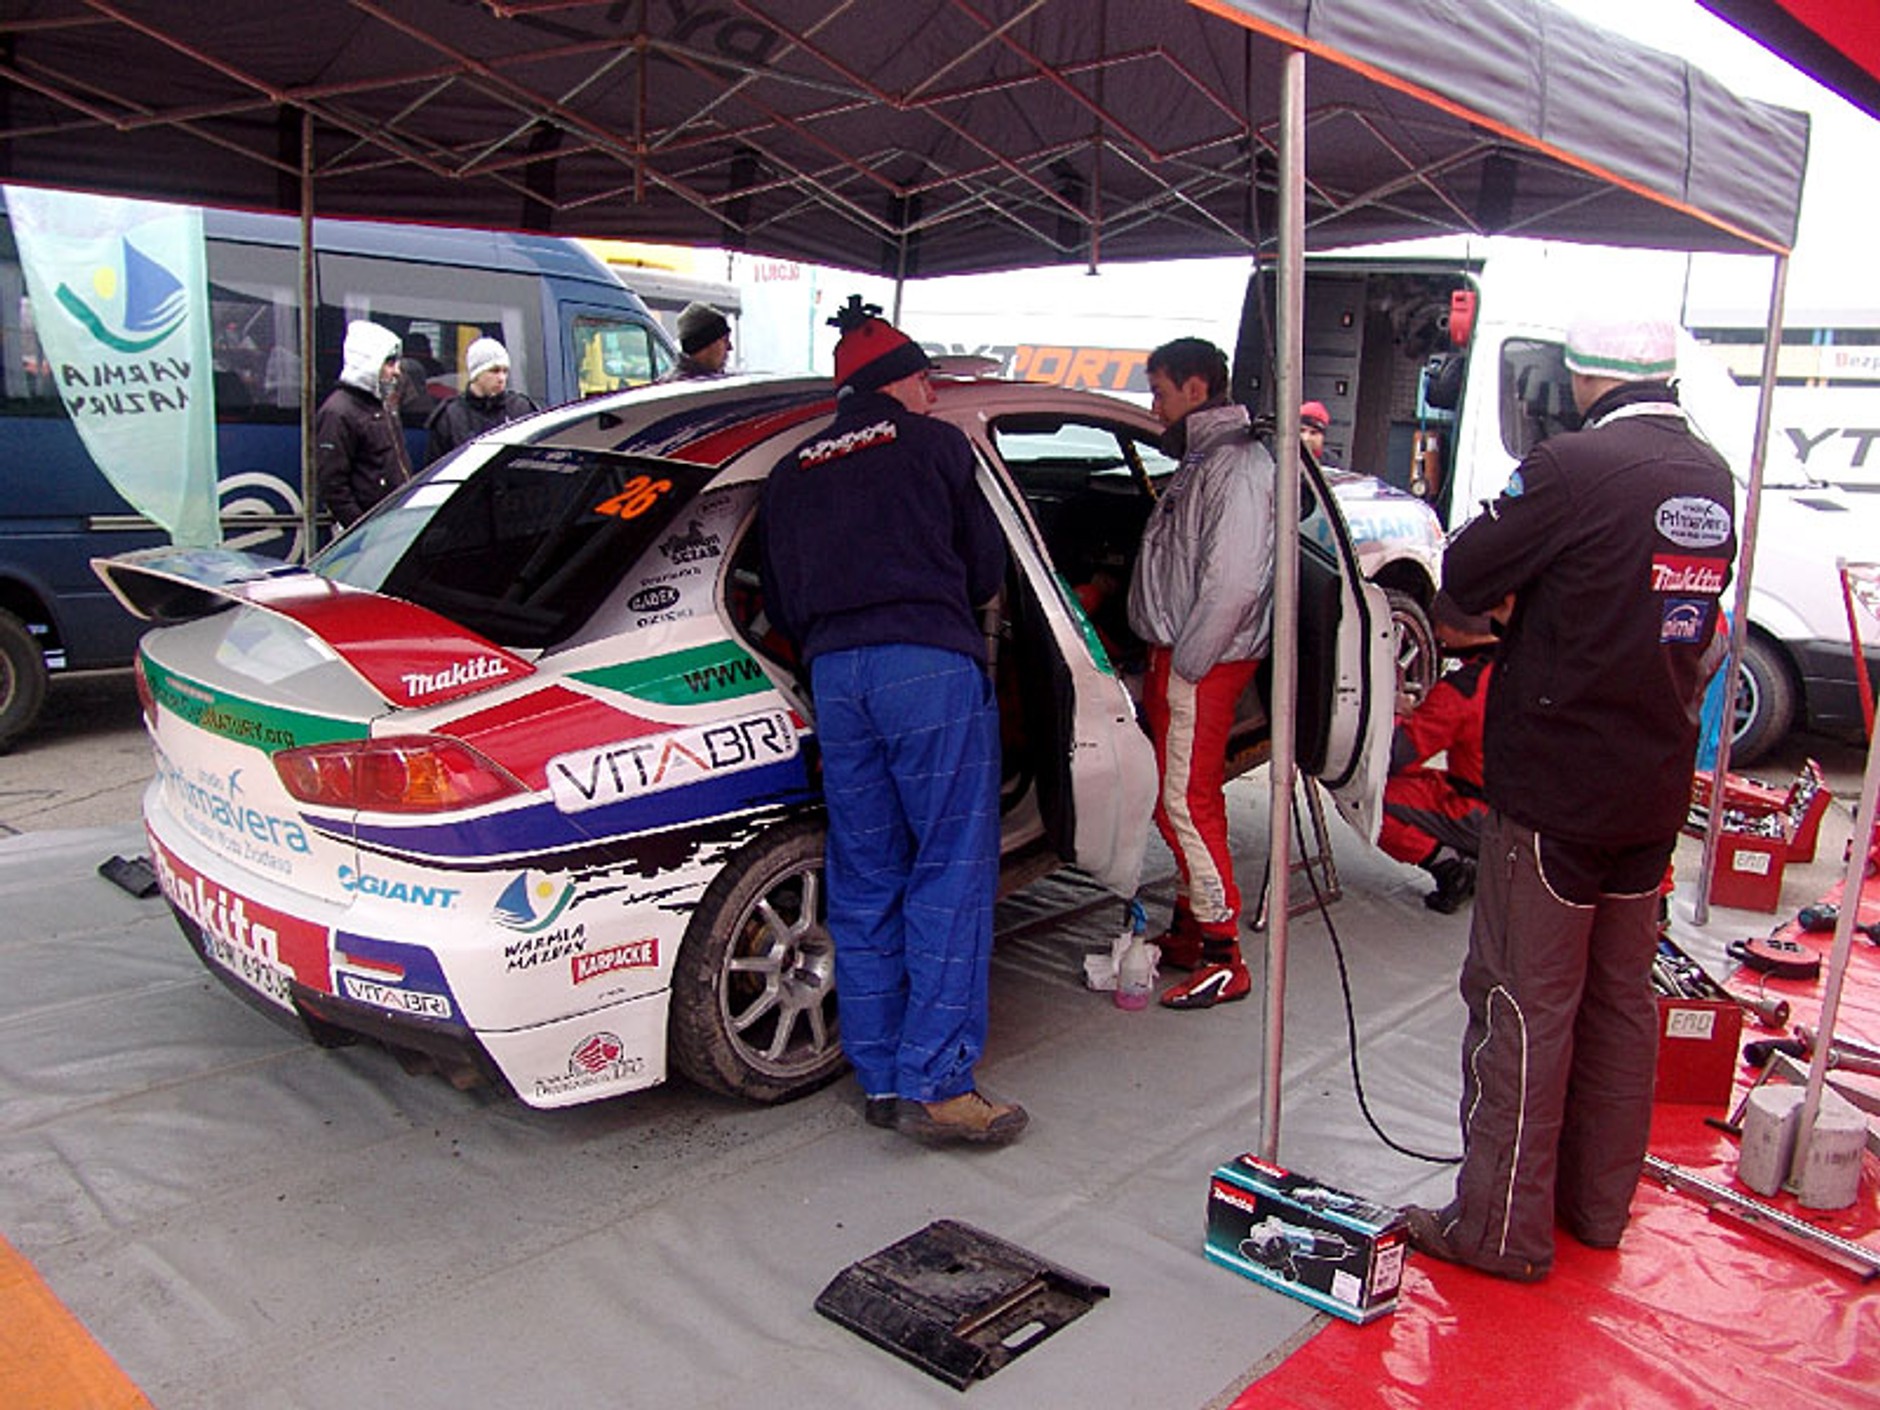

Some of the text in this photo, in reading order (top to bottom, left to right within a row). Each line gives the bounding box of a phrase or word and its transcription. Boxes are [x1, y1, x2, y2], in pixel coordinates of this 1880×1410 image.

[593, 475, 672, 520] 26
[1349, 517, 1430, 546] GIAN
[356, 873, 461, 909] GIANT
[504, 923, 585, 958] WARMIA
[577, 944, 653, 978] KARPACKIE
[350, 976, 448, 1015] VITABRI
